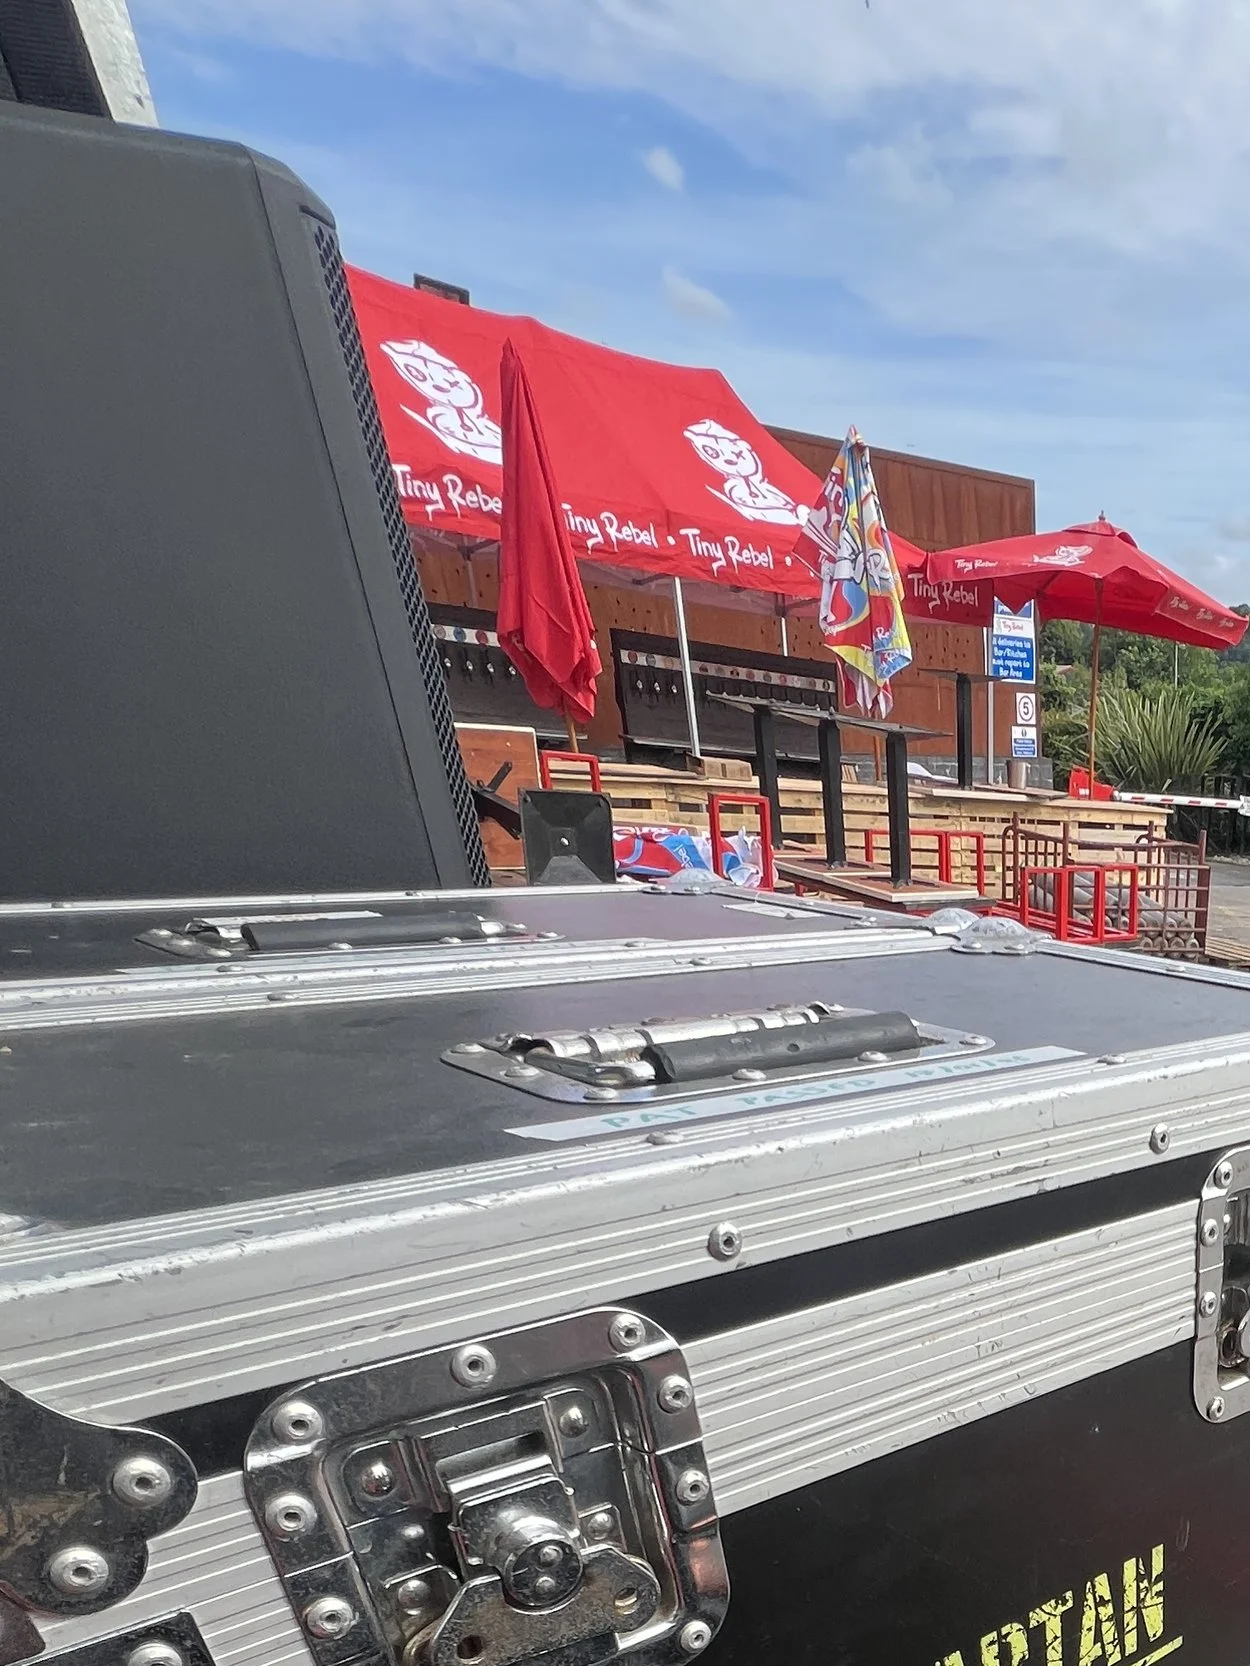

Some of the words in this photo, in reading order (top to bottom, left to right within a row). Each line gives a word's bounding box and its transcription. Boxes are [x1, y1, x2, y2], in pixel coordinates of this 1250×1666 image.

[393, 463, 442, 521] Tiny
[442, 473, 501, 518] Rebe
[604, 511, 658, 552] Rebel
[679, 528, 727, 577] Tiny
[727, 539, 774, 574] Rebel
[955, 558, 973, 574] Tiny
[908, 573, 940, 614] Tiny
[942, 582, 979, 612] Rebel
[1023, 702, 1029, 715] 5
[602, 1105, 697, 1128] PAT
[741, 1077, 876, 1105] PASSED
